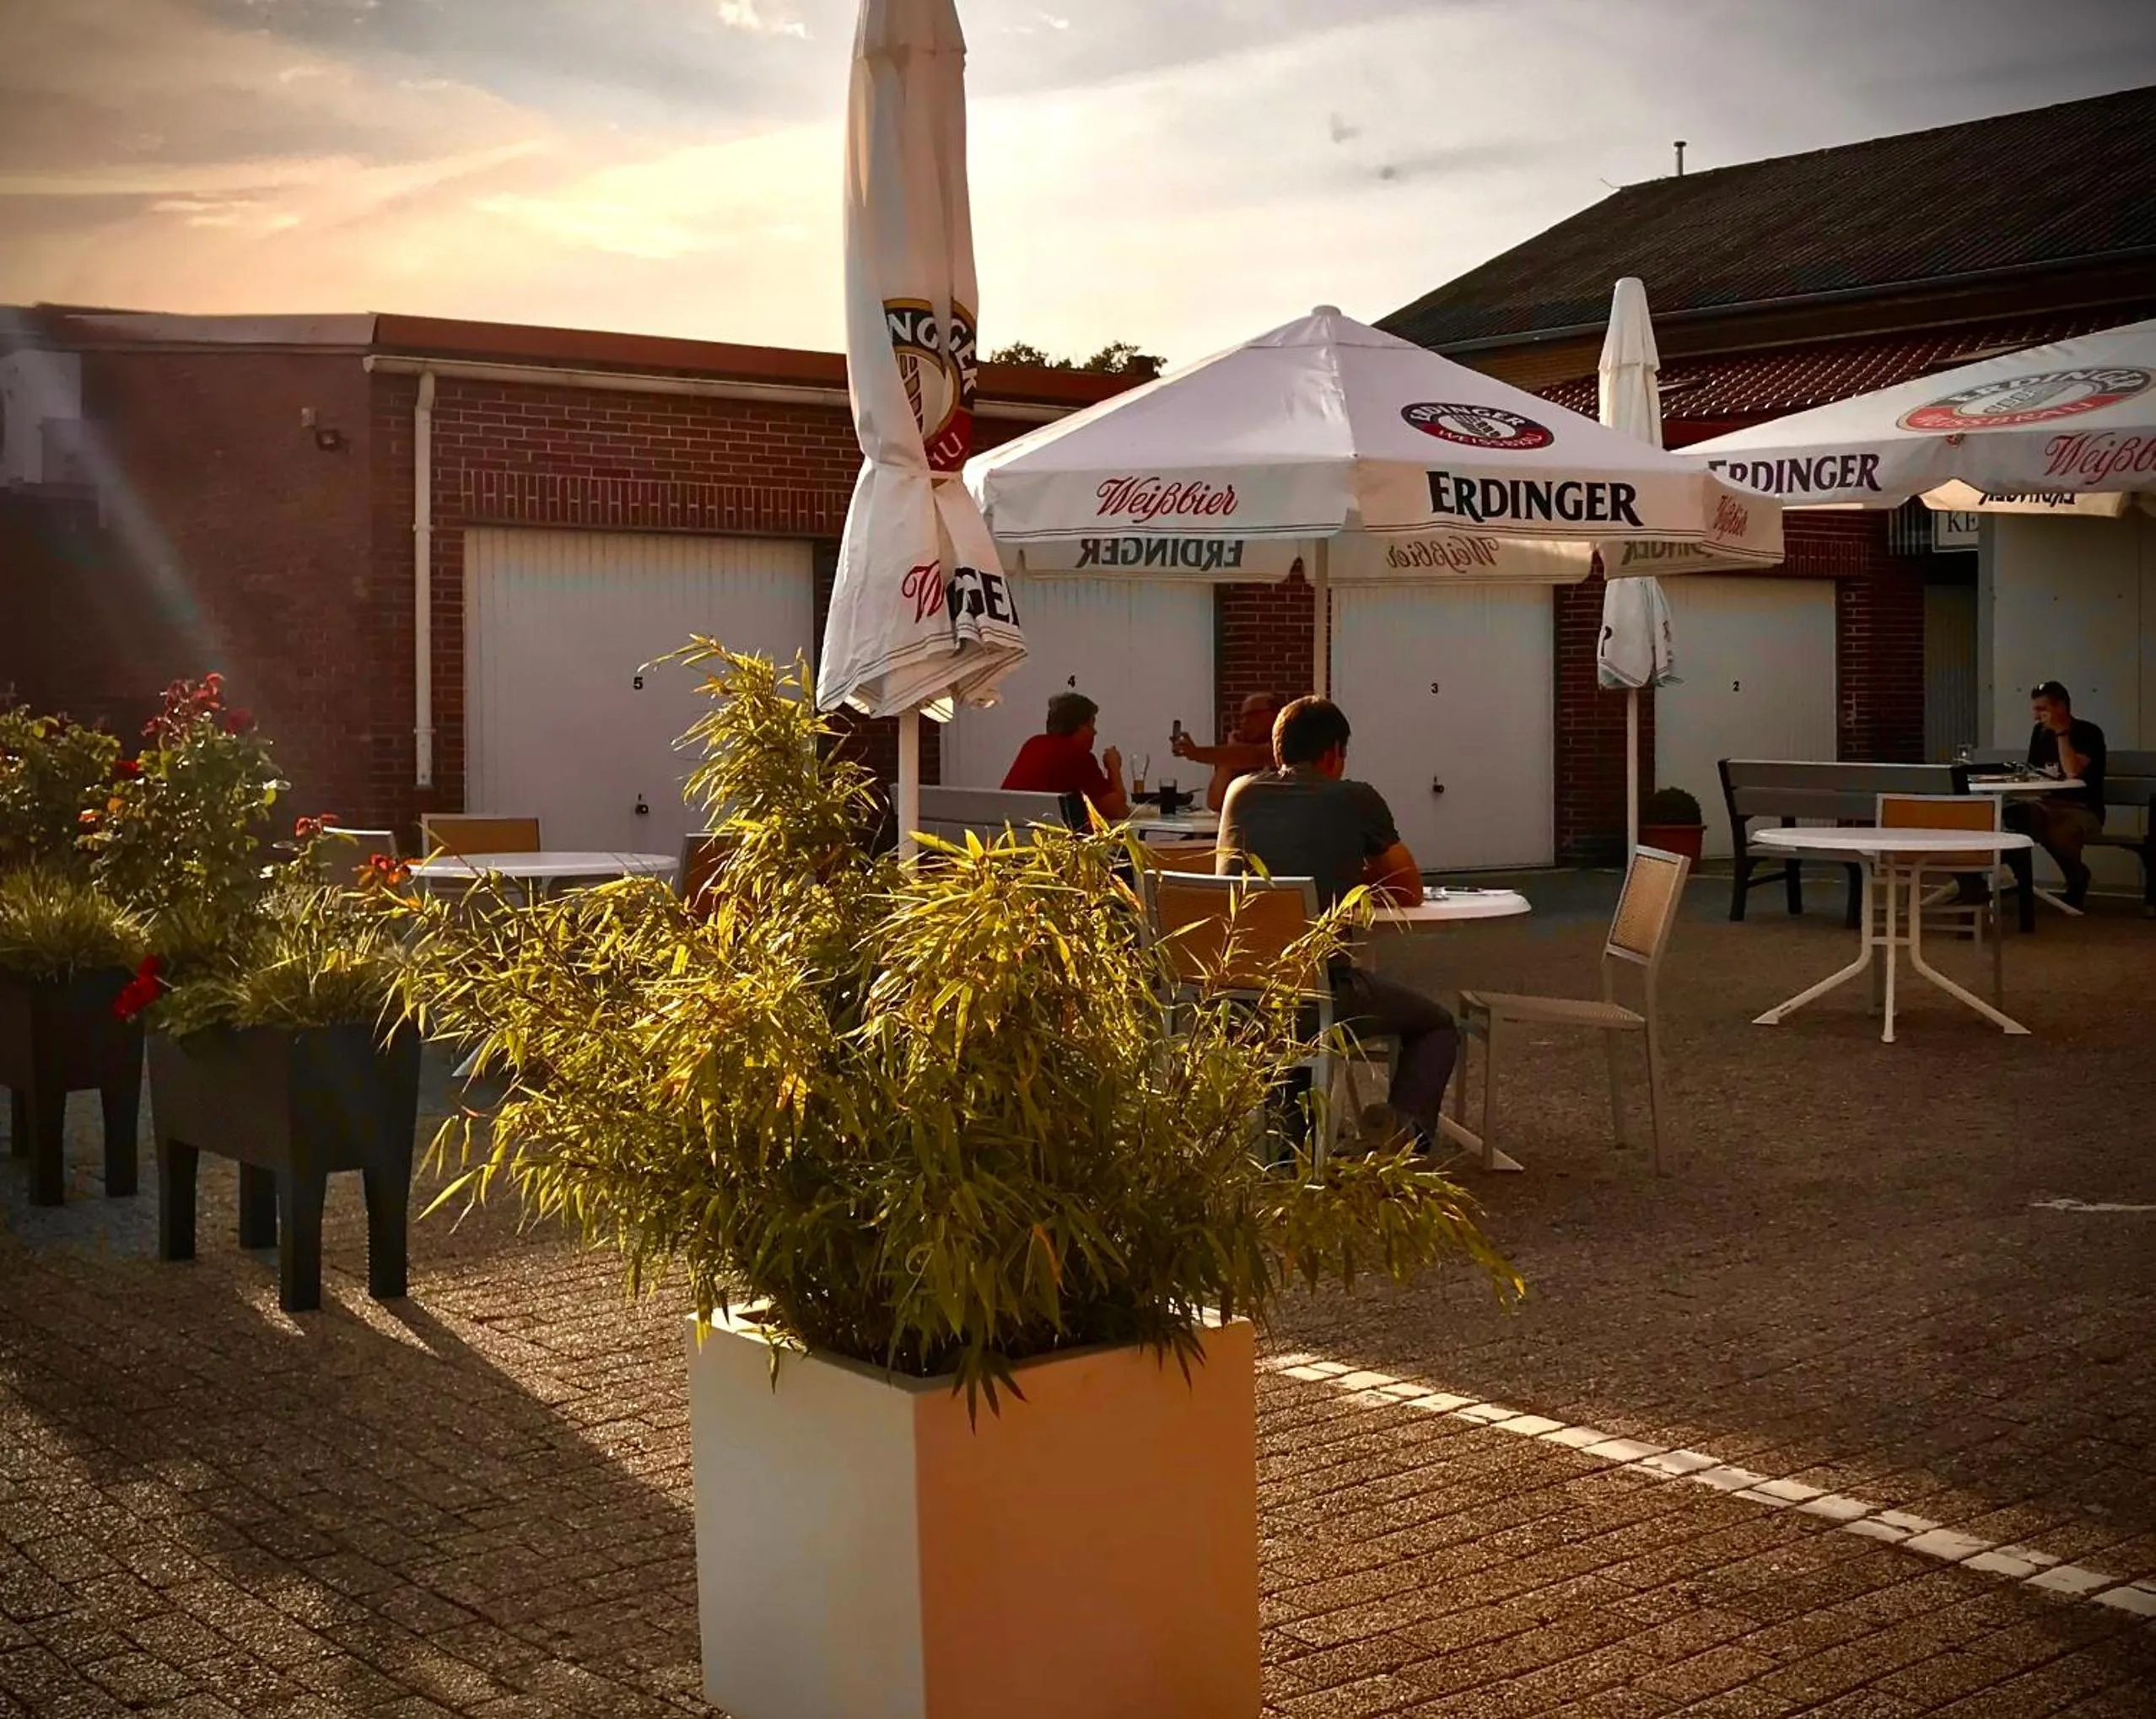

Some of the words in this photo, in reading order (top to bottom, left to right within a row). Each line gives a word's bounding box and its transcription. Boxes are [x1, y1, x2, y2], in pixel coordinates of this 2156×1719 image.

[2043, 431, 2156, 486] Weißb
[1096, 476, 1238, 524] Weißbier
[1426, 471, 1644, 527] ERDINGER
[633, 676, 644, 690] 5
[1067, 675, 1075, 688] 4
[1431, 682, 1438, 694] 3
[1733, 681, 1740, 692] 2
